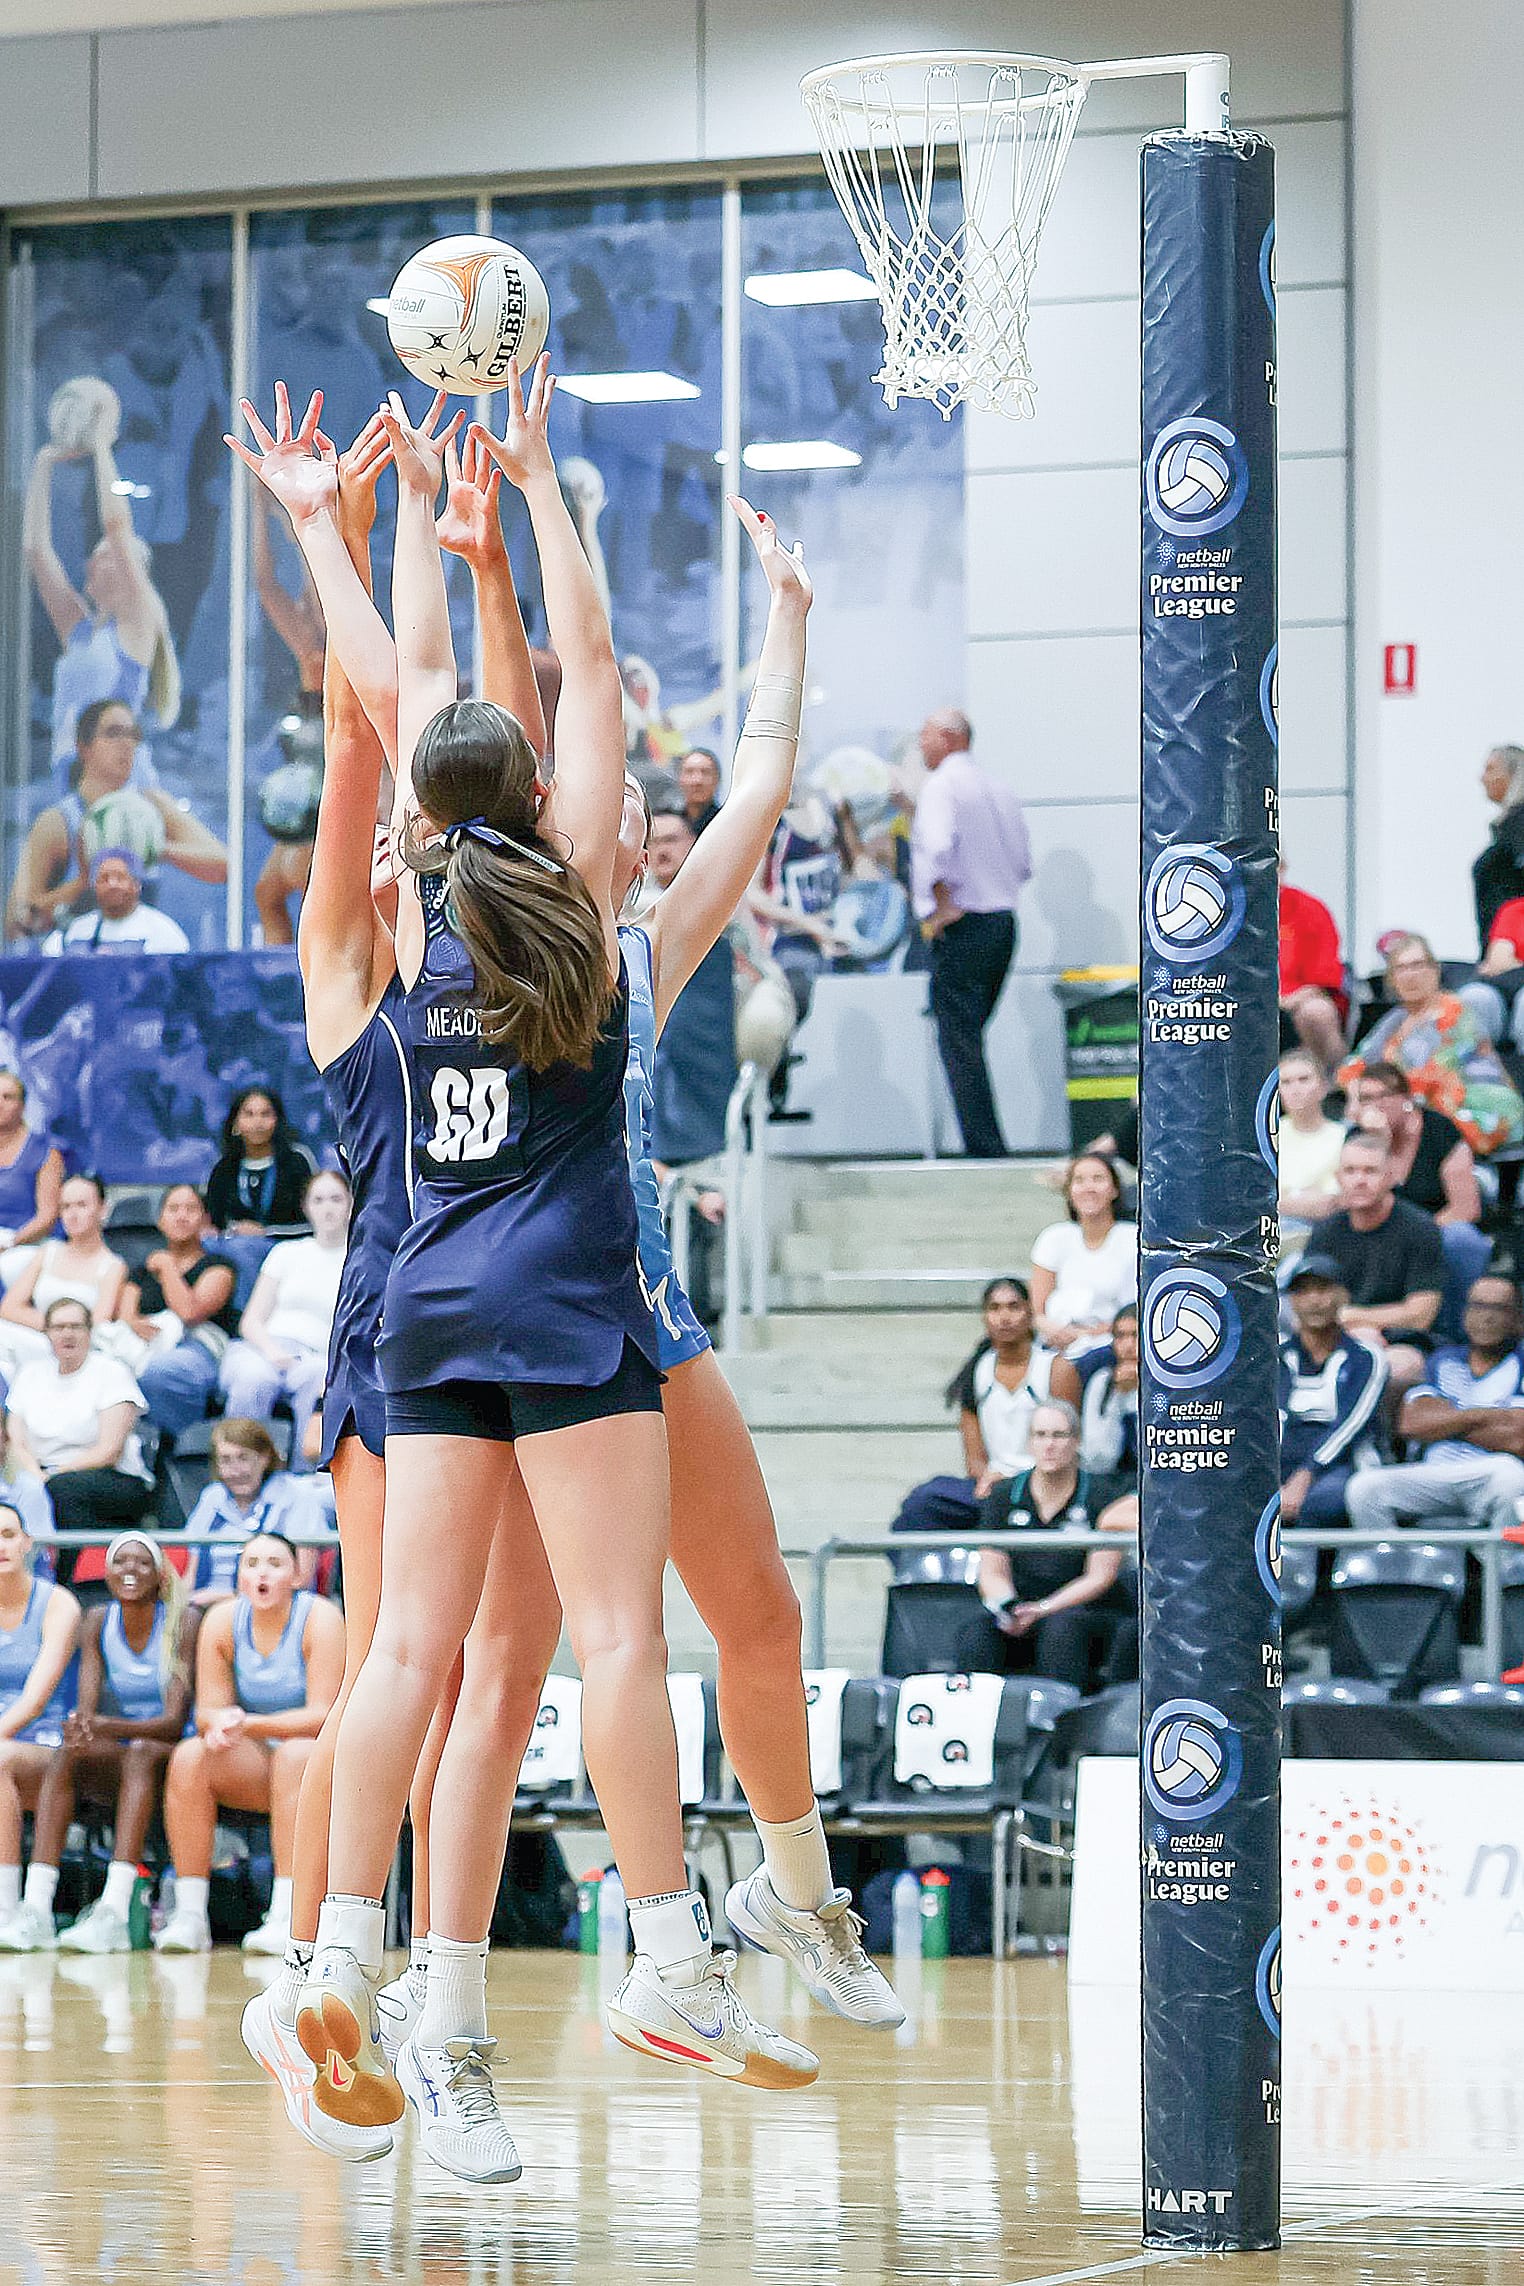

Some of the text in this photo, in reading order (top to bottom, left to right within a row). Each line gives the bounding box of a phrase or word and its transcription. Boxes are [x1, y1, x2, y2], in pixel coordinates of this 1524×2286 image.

[487, 265, 522, 376] GILBERT
[1177, 548, 1231, 563] netball
[1150, 571, 1243, 596] Premier
[1154, 597, 1236, 619] League
[1173, 975, 1226, 989] netball
[1148, 997, 1238, 1019] Premier
[1151, 1021, 1231, 1045] League
[426, 1067, 509, 1162] GD
[1169, 1401, 1223, 1415] netball
[1146, 1424, 1236, 1446] Premier
[1150, 1447, 1228, 1472] League
[1170, 1833, 1224, 1847] netball
[1150, 1878, 1230, 1905] League
[1147, 2187, 1233, 2214] HART
